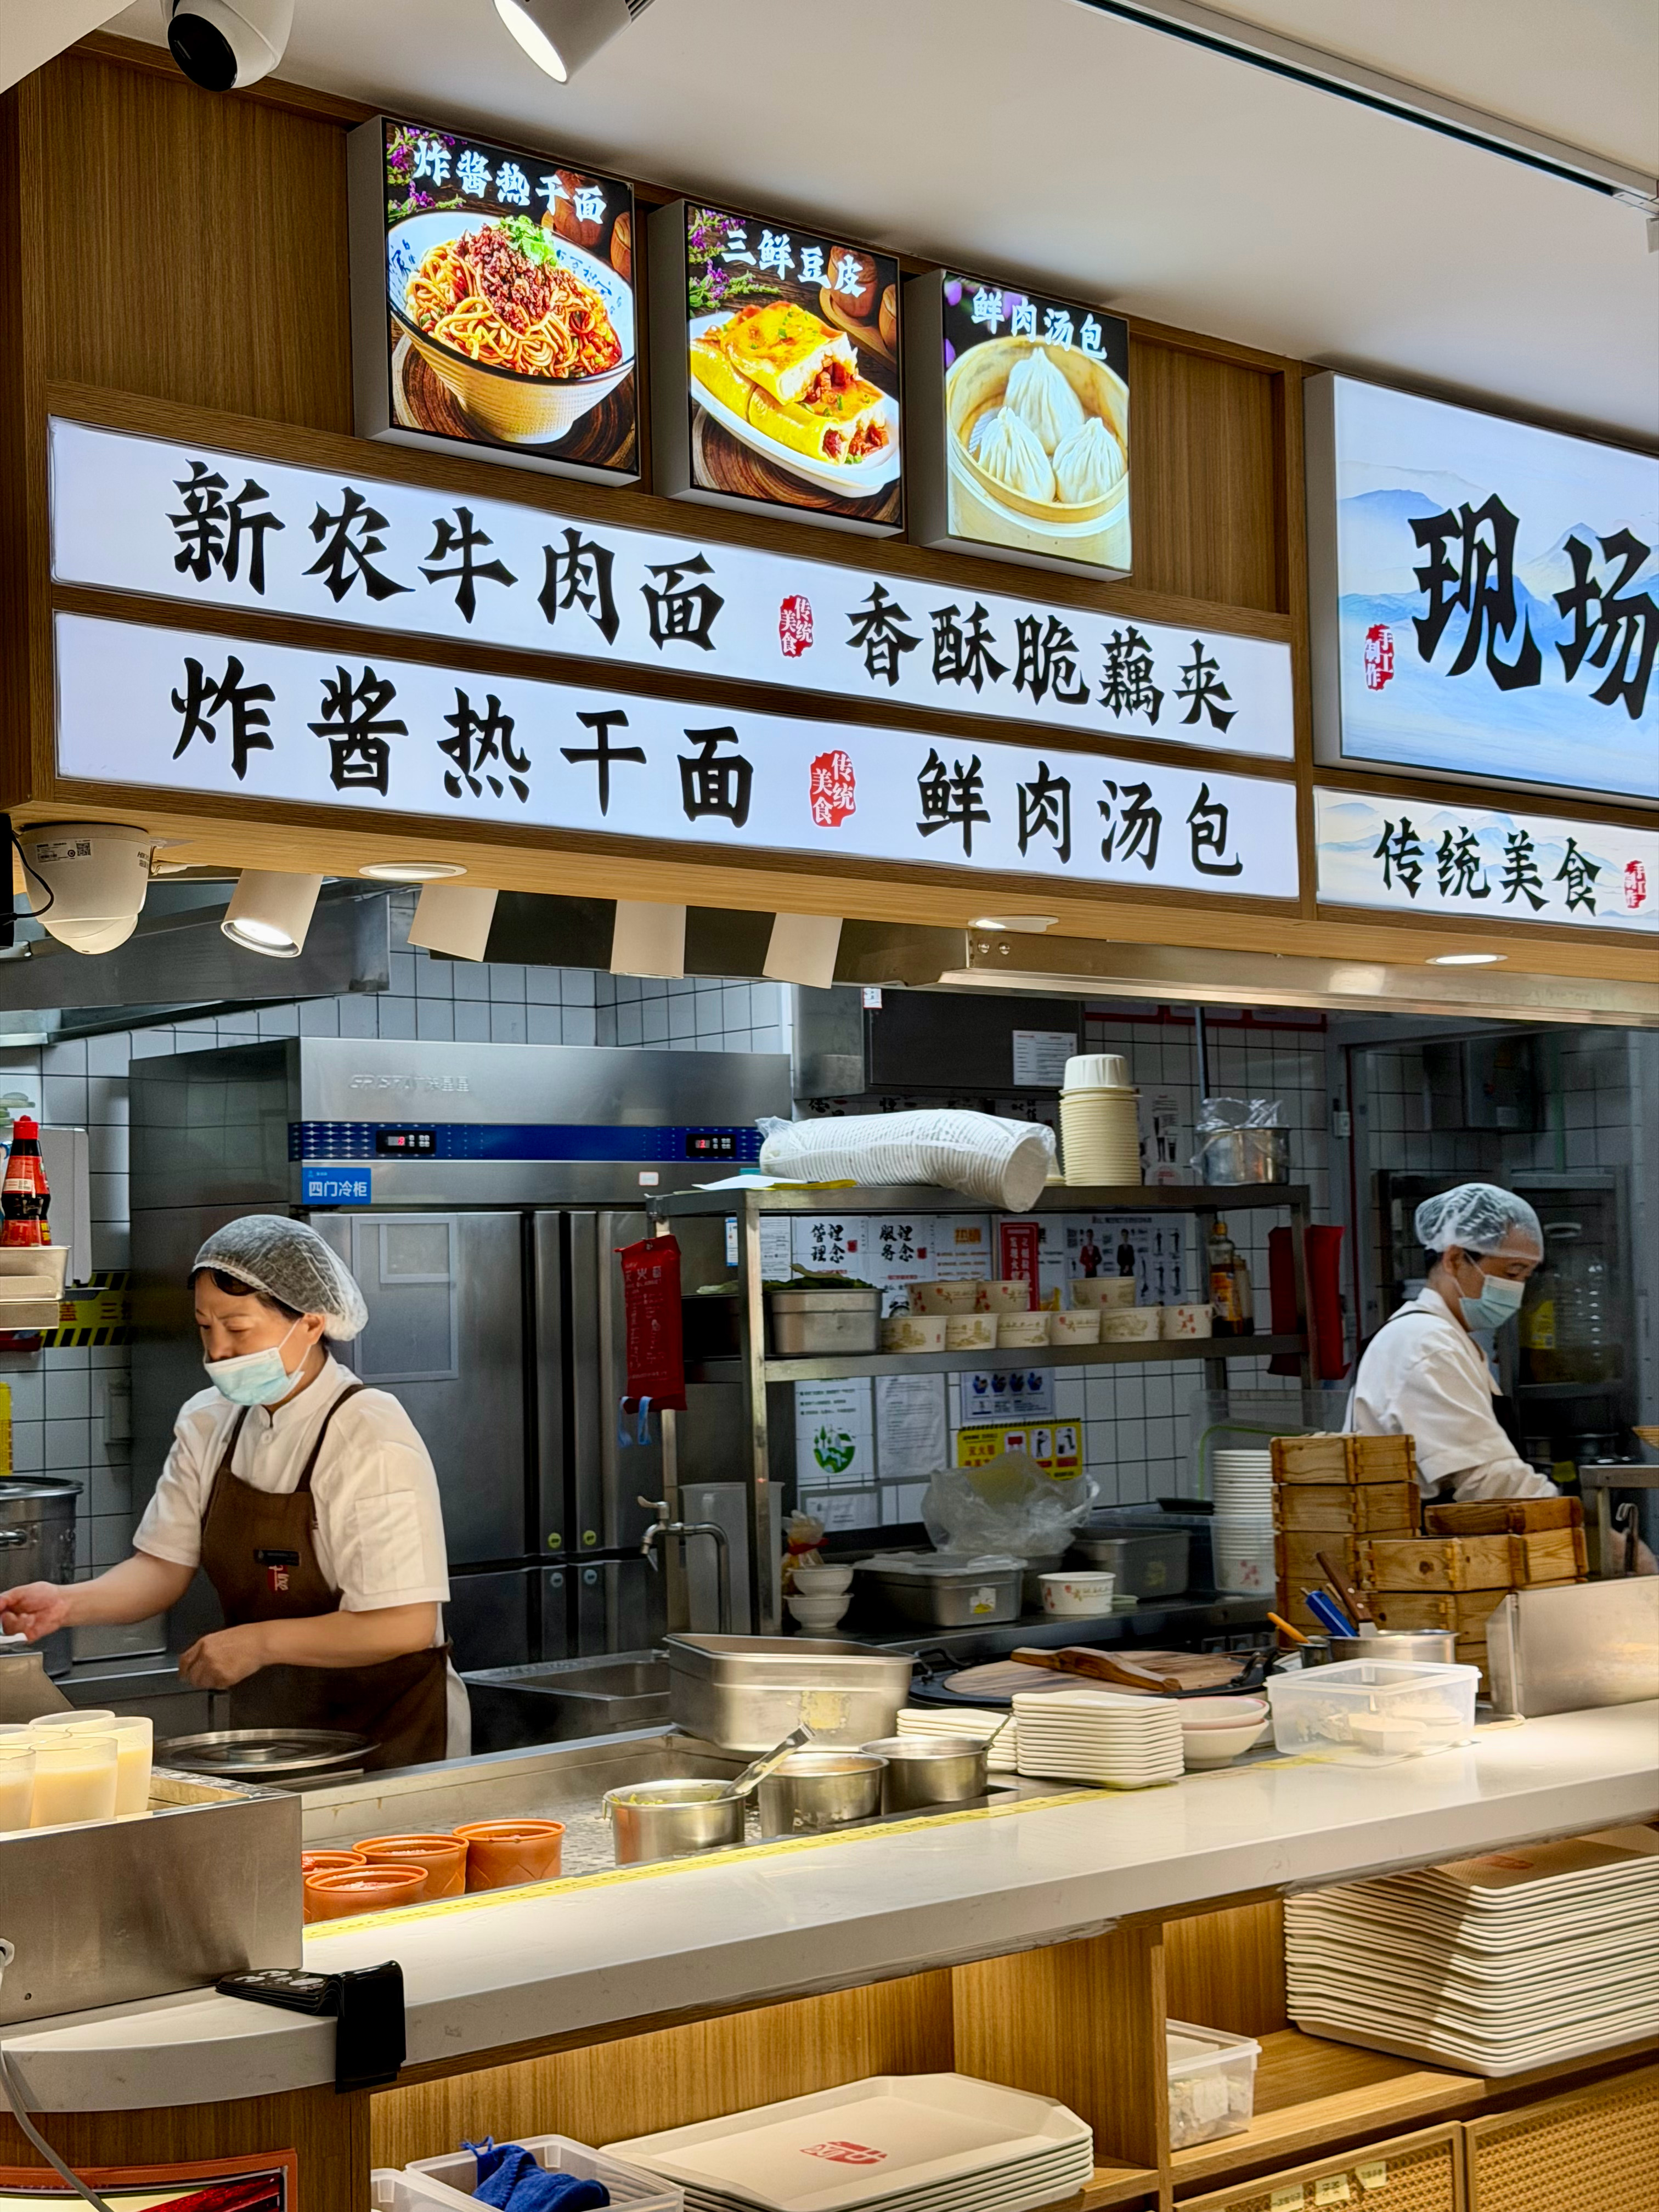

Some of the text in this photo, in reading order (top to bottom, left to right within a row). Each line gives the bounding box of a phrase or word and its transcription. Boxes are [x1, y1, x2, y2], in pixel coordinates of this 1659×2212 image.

[413, 139, 607, 225] 炸酱热干面
[717, 229, 866, 298] 三鲜豆皮
[971, 287, 1107, 360] 鲜肉汤包
[166, 461, 725, 652] 新农牛肉面
[1407, 493, 1659, 720] 现场
[845, 581, 1239, 734] 香酥脆藕夹
[171, 655, 753, 828] 炸酱热干面
[916, 747, 1243, 877] 鲜肉汤包
[1373, 816, 1601, 917] 传统美食
[308, 1181, 368, 1197] 四门冷柜
